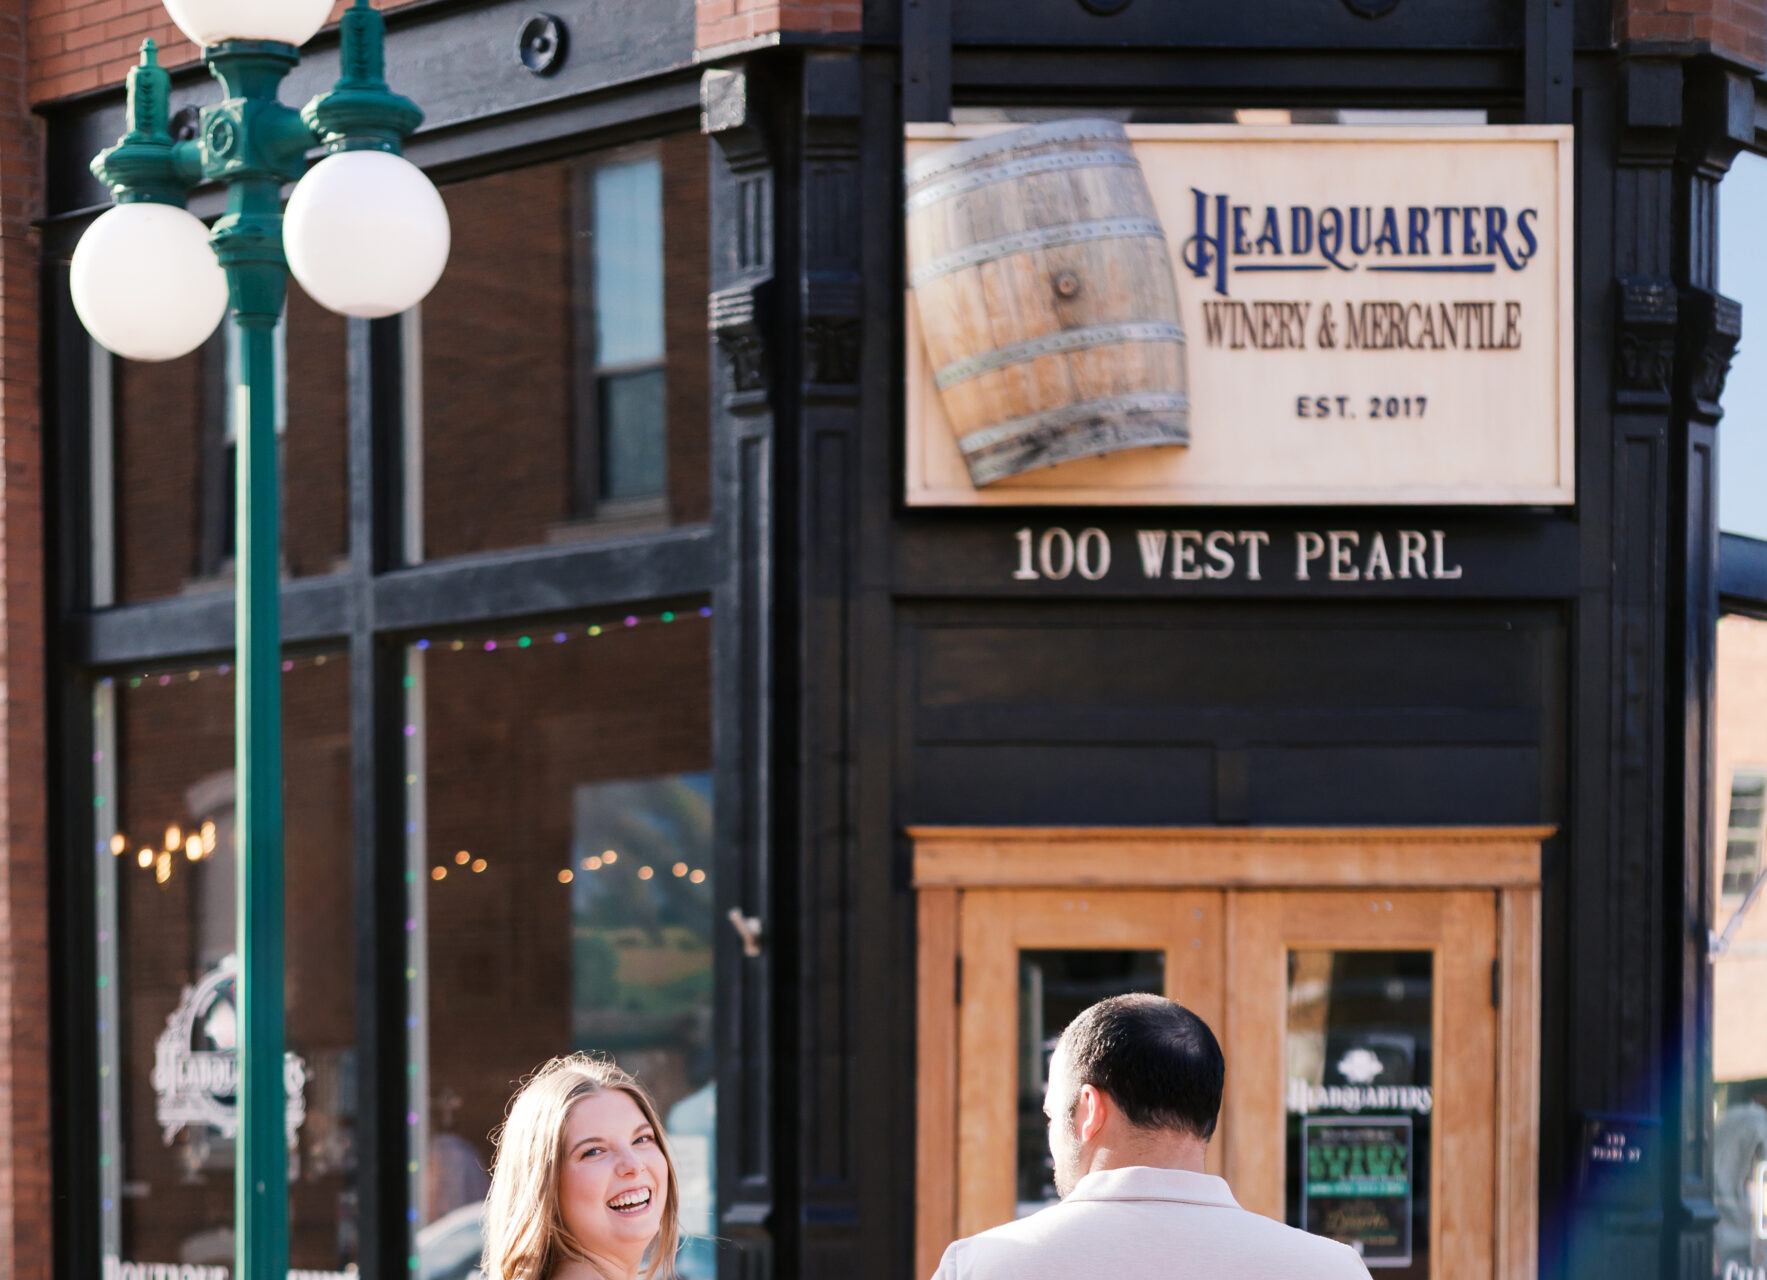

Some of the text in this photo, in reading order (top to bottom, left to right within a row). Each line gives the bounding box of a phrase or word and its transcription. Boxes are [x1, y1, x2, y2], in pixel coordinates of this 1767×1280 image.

[1182, 187, 1538, 296] HEADQUARTERS
[1203, 301, 1522, 350] WINERY & MERCANTILE
[1296, 396, 1428, 419] EST. 2017
[1012, 527, 1462, 581] 100 WEST PEARL
